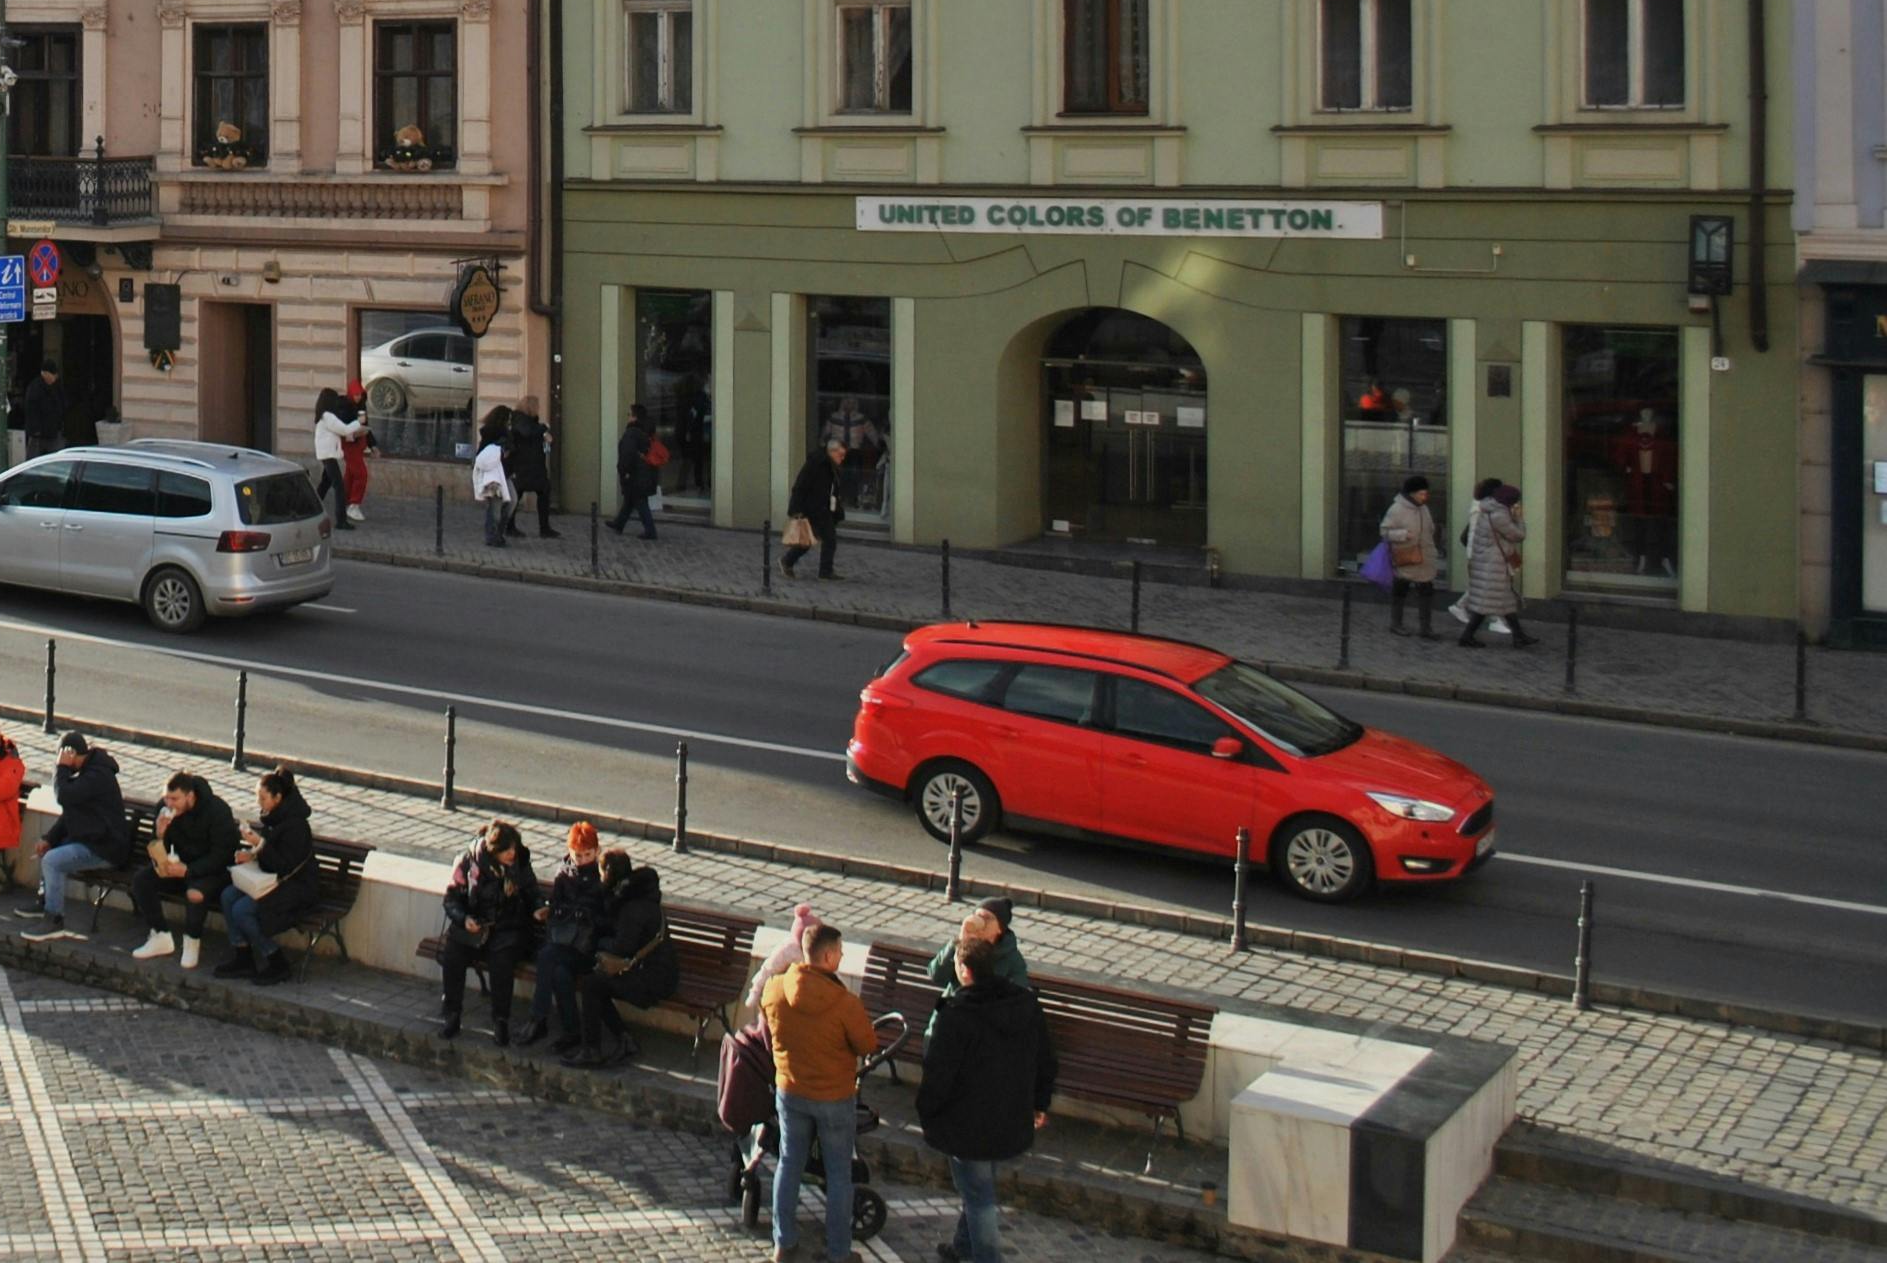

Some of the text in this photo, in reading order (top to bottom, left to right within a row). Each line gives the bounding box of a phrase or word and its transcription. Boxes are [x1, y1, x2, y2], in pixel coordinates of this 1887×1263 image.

[878, 204, 1332, 230] UNITED COLORS OF BENETTON
